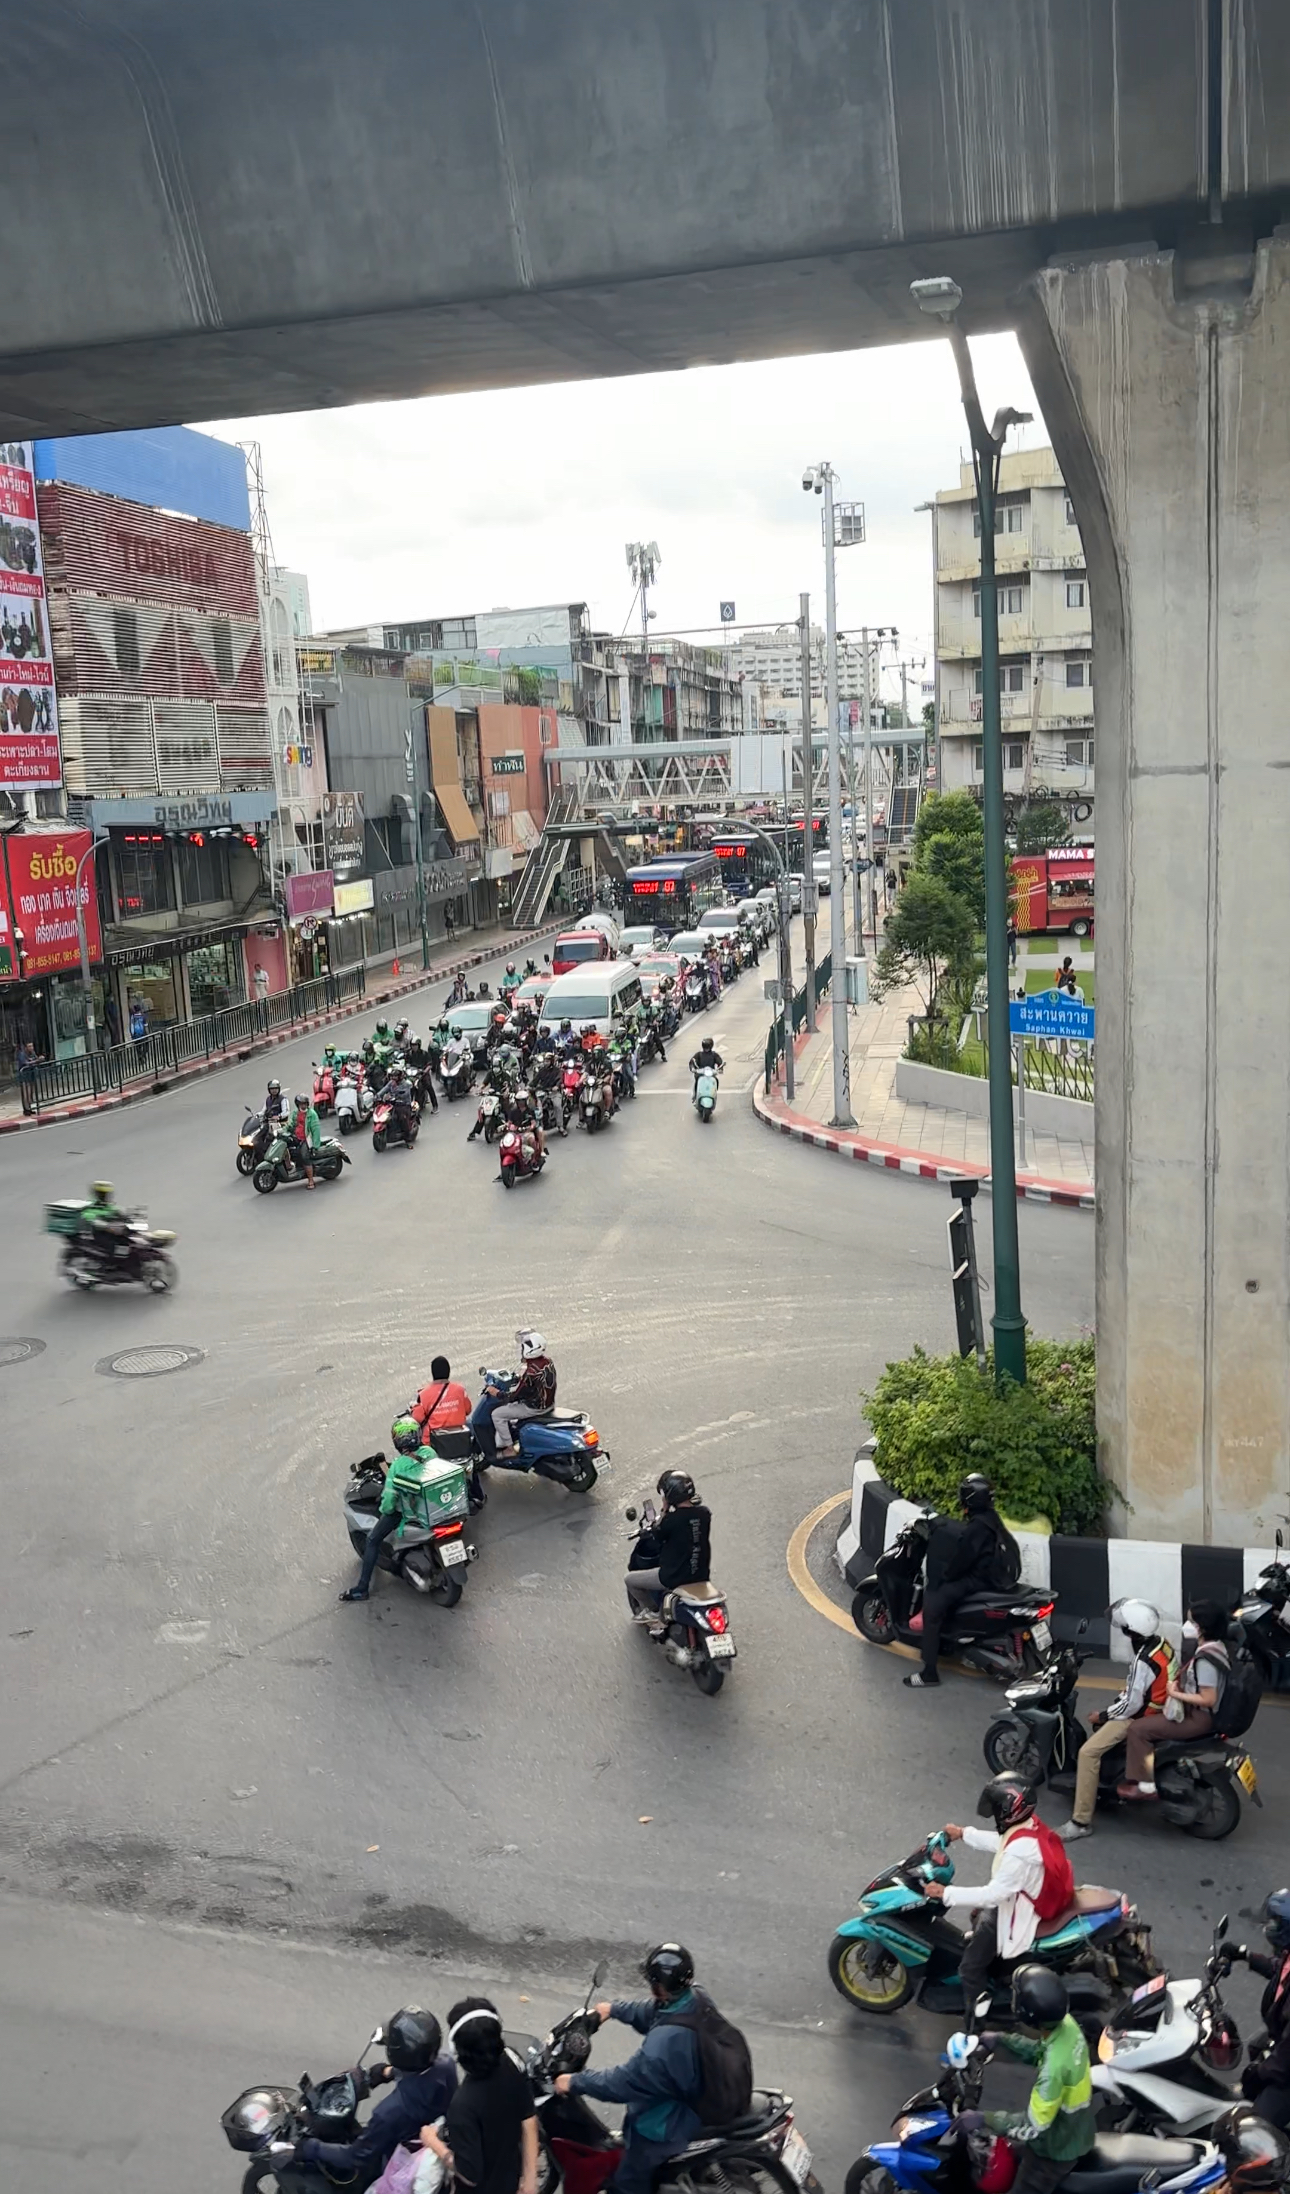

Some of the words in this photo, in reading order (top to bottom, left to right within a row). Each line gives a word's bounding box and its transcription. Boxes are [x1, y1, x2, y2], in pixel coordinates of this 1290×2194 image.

[117, 535, 218, 587] TOSHIBA
[30, 843, 77, 880] รับซื้อ
[1048, 849, 1084, 860] MAMA
[20, 894, 37, 914] ทอง
[1020, 1007, 1088, 1024] สะพานควาย
[1025, 1023, 1056, 1034] Saphan
[1060, 1026, 1085, 1036] Khwai
